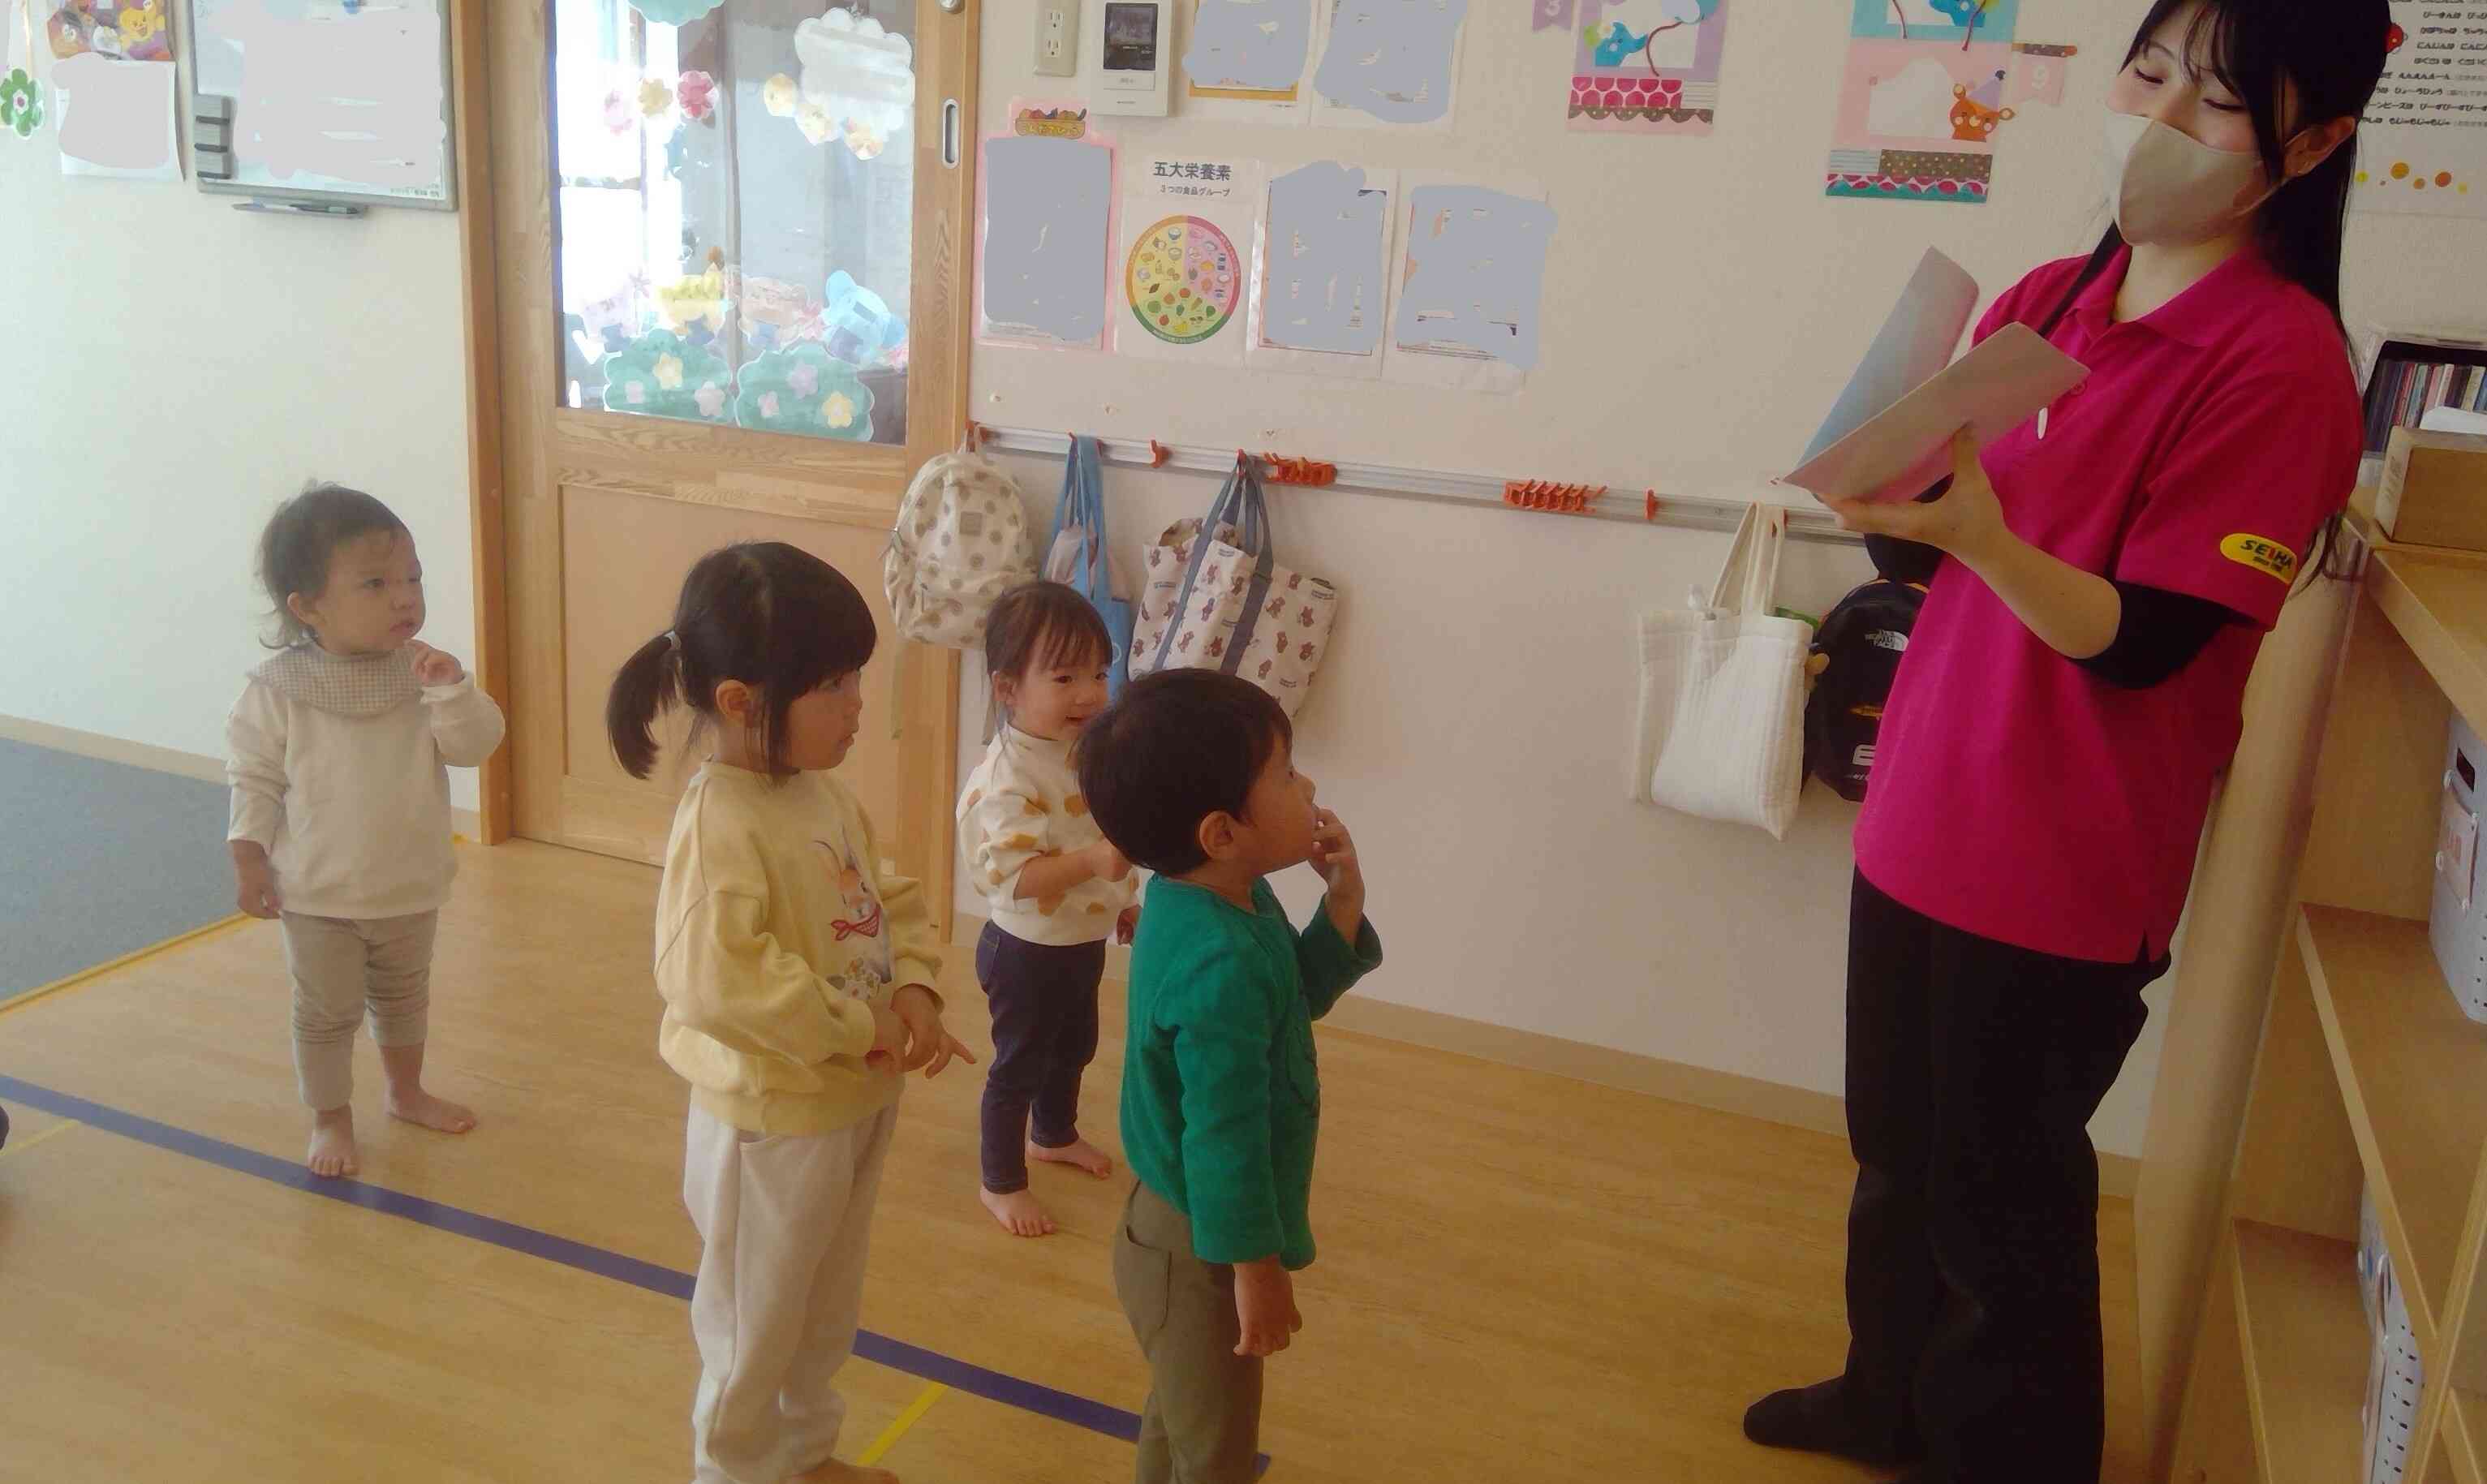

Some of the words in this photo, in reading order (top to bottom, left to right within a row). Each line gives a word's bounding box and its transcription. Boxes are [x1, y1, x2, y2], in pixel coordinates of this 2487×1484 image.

[1153, 161, 1232, 181] 五大栄養素
